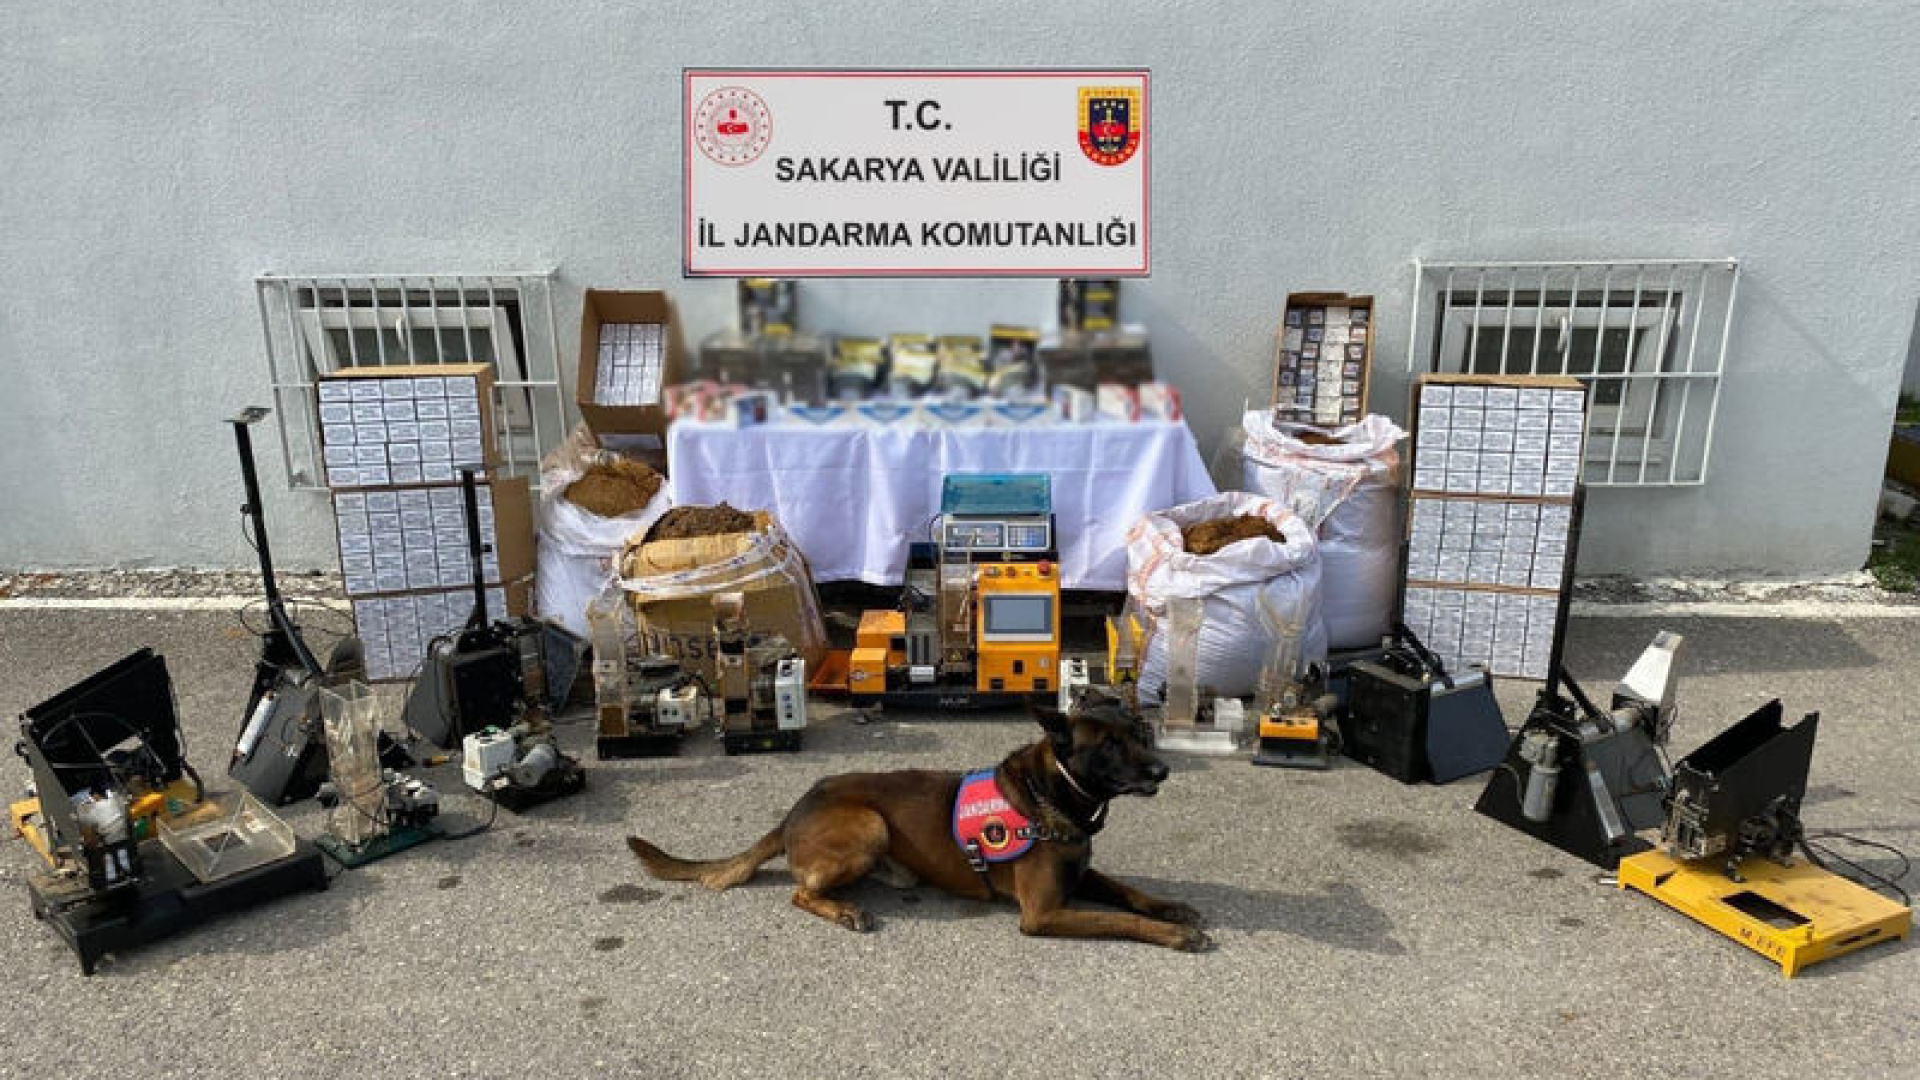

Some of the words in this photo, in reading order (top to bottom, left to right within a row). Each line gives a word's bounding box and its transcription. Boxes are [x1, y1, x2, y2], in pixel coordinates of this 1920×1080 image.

[884, 101, 951, 130] T.C.
[775, 158, 924, 182] SAKARYA
[932, 152, 1060, 182] VALİLİĞİ
[698, 218, 725, 247] İL
[734, 223, 912, 247] JANDARMA
[920, 218, 1136, 247] KOMUTANLIĞI
